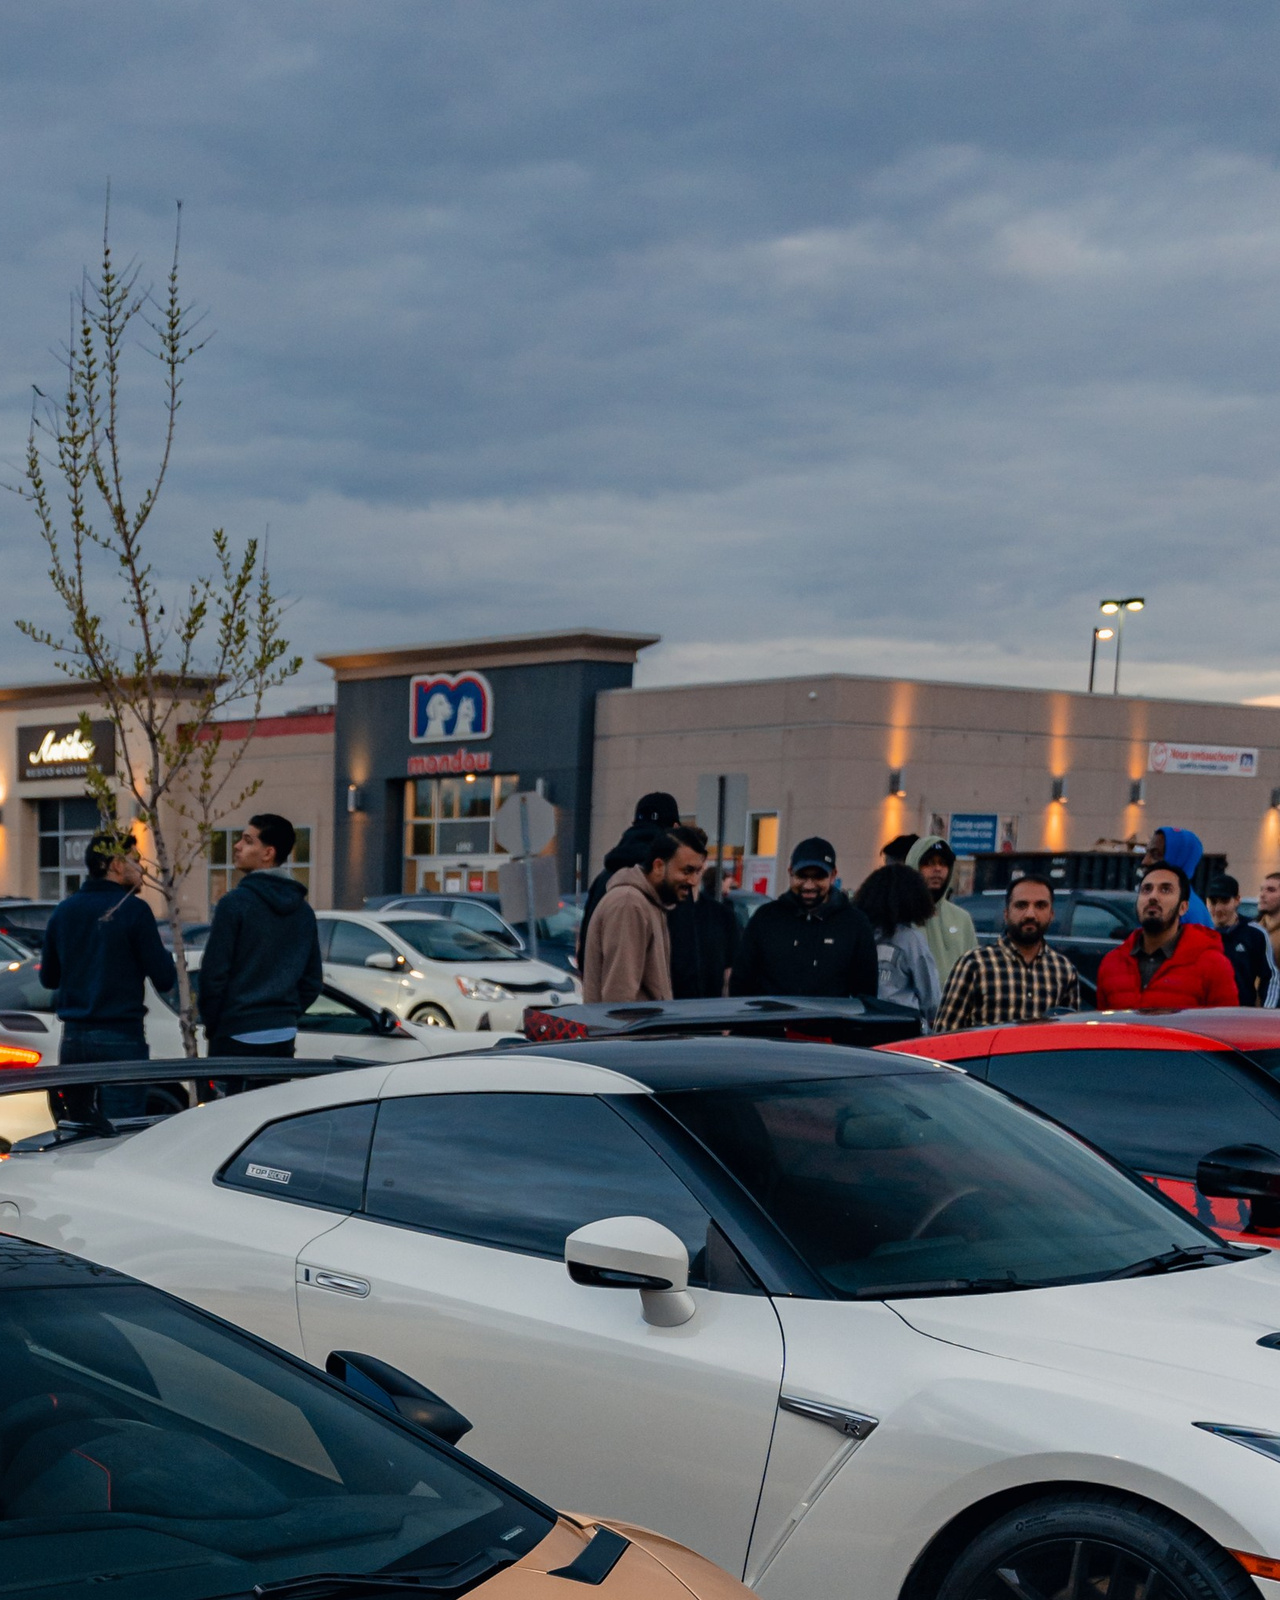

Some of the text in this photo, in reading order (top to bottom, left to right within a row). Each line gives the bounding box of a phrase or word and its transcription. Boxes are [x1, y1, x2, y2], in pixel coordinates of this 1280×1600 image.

[407, 748, 491, 775] mondou
[62, 764, 102, 776] LOUNE
[251, 1167, 289, 1182] TOP SECRET
